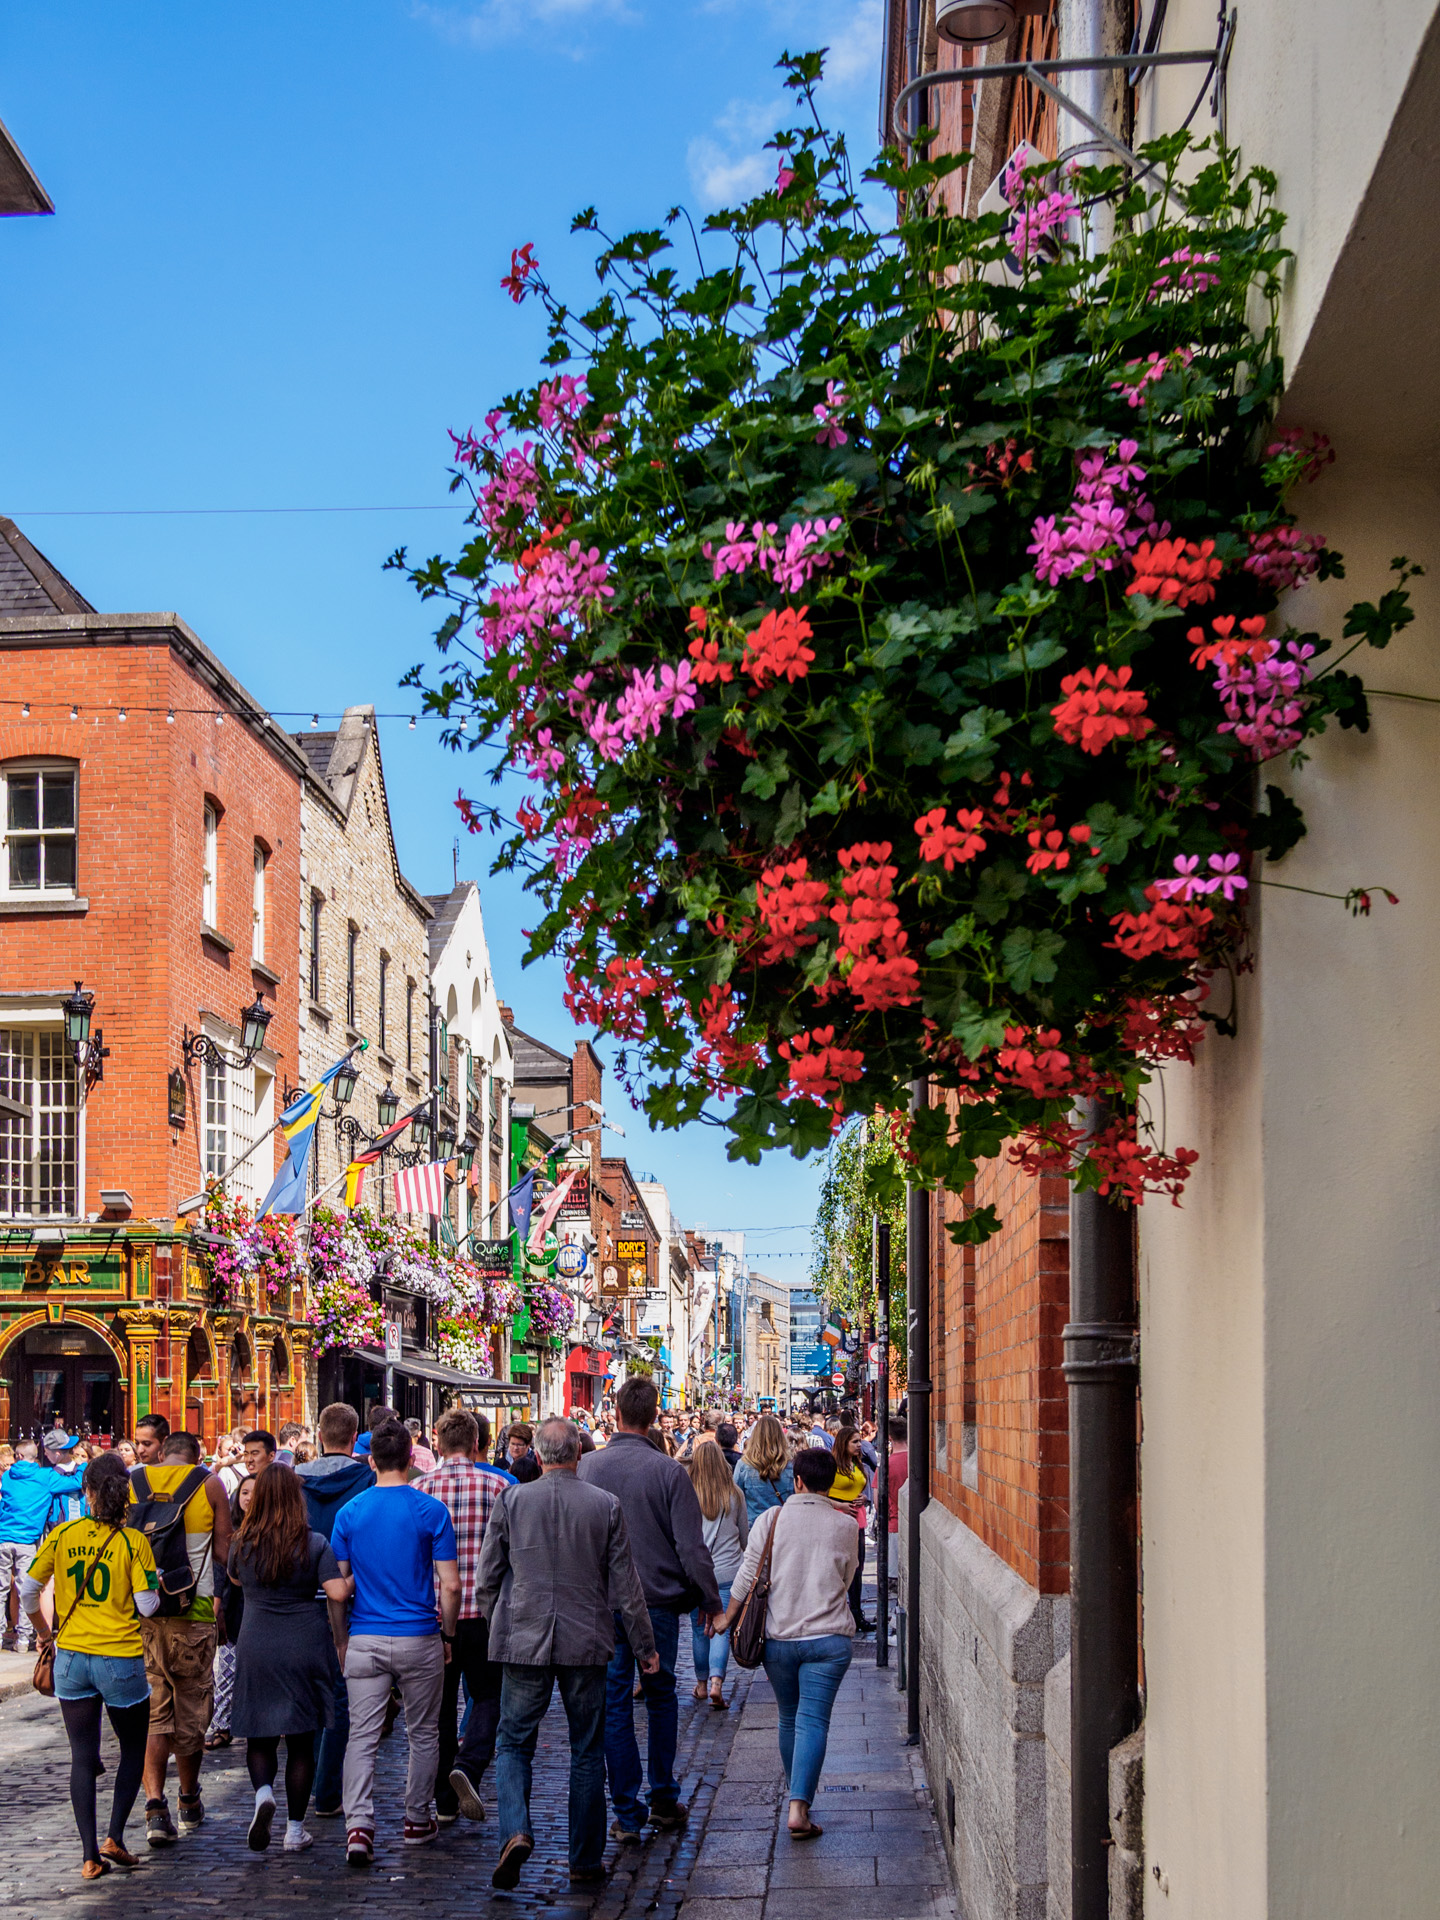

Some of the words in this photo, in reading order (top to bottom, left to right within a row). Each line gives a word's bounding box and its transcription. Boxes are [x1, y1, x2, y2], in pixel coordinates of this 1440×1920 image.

[475, 1242, 509, 1257] Quays
[618, 1241, 646, 1252] RORY'S
[559, 1252, 580, 1267] HARP
[24, 1260, 91, 1284] BAR
[67, 1560, 111, 1602] 10
